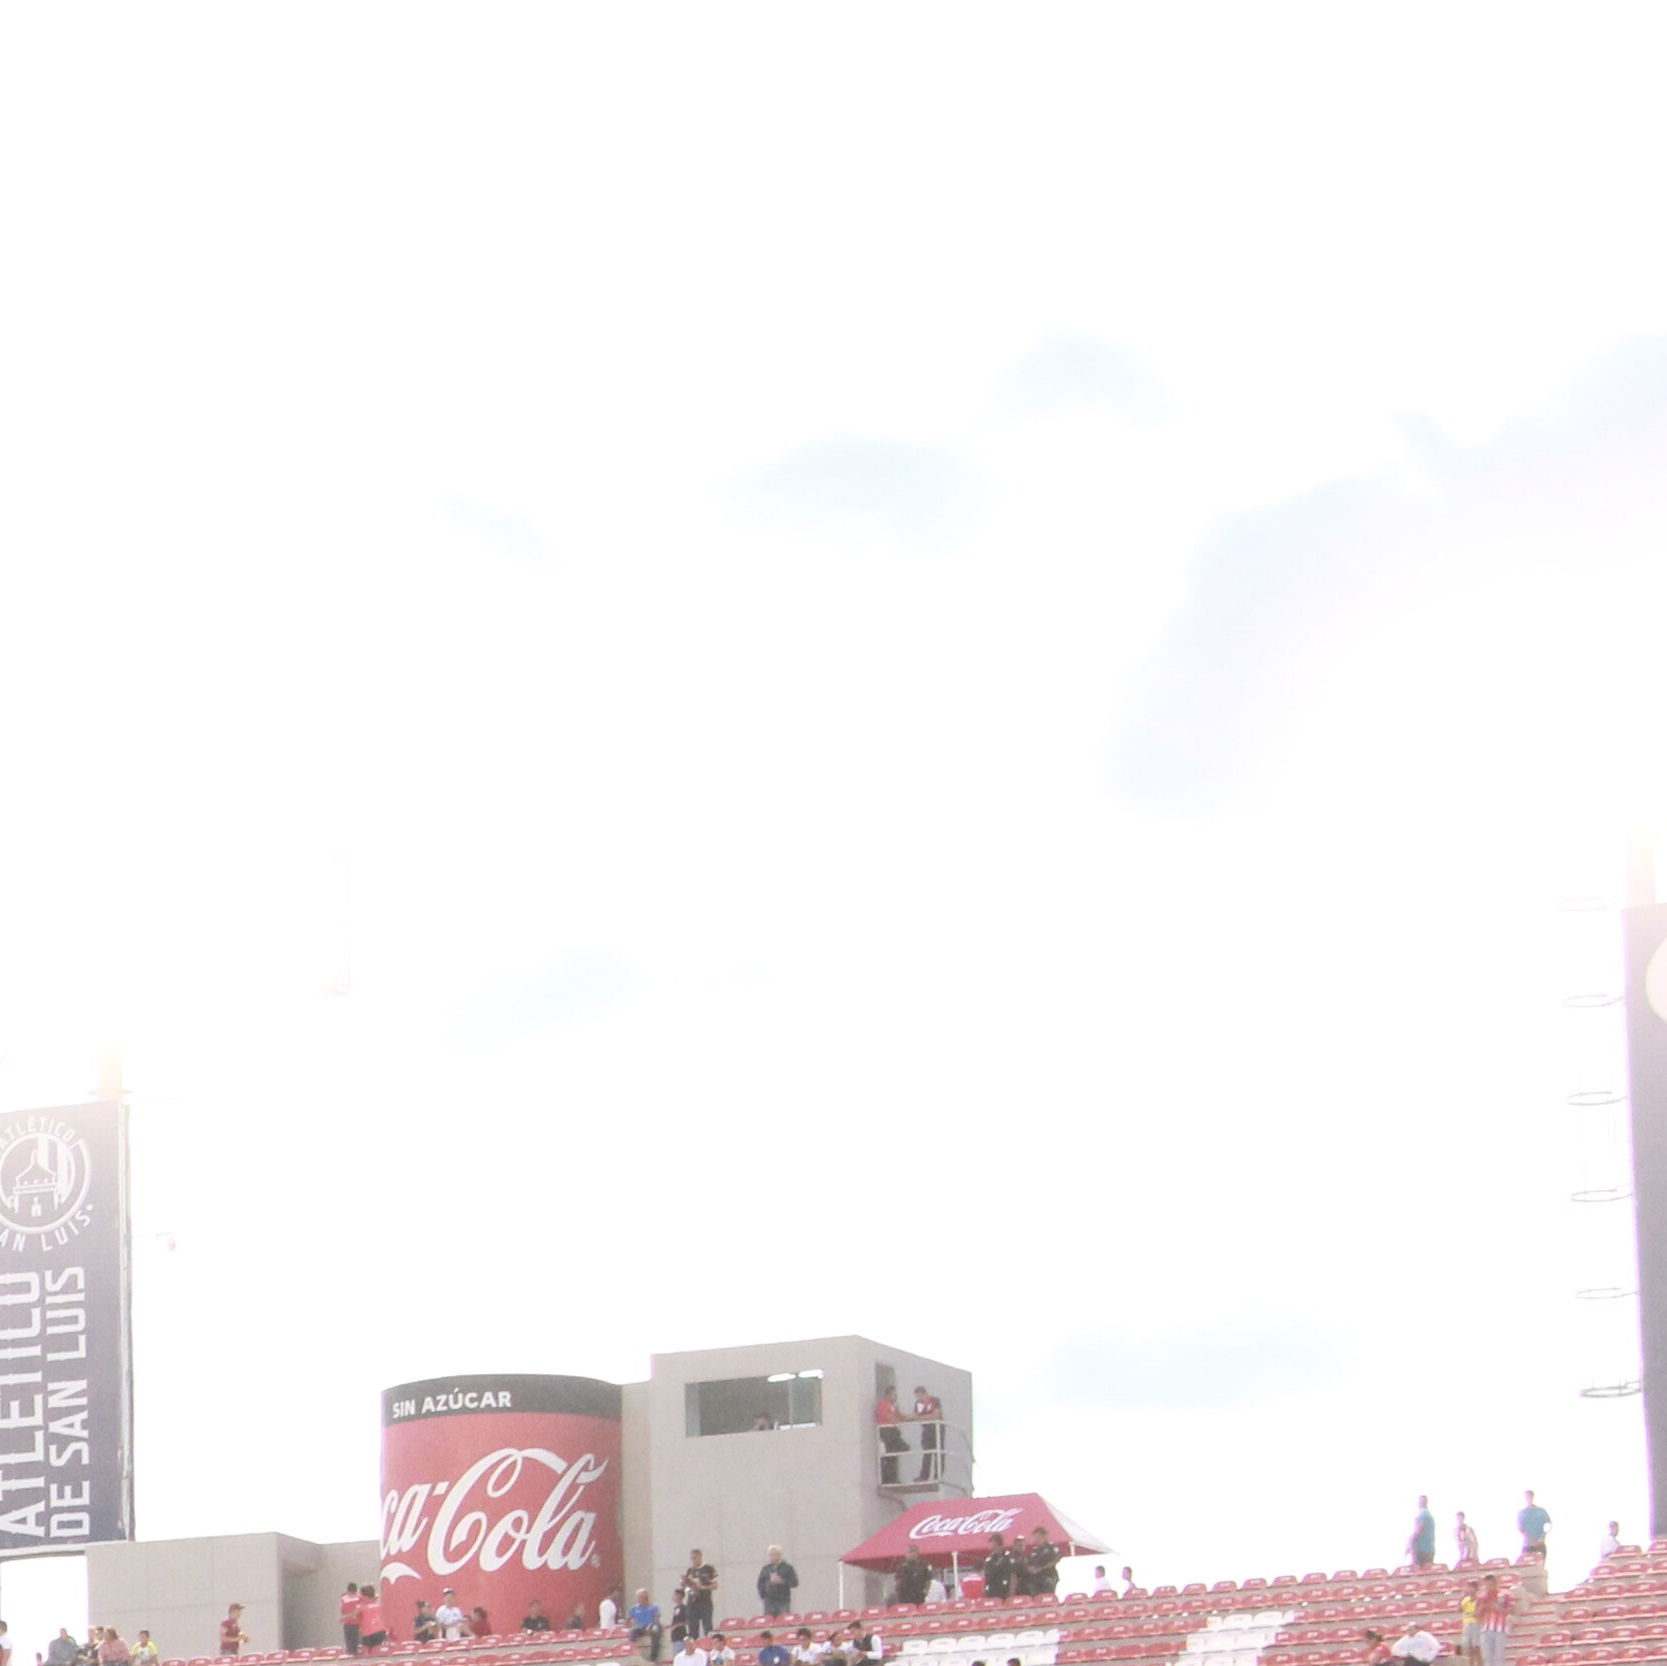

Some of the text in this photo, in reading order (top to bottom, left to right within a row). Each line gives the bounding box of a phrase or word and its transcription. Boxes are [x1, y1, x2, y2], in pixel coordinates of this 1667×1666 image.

[45, 1266, 91, 1538] DE SAN LUIS
[393, 1387, 512, 1418] SIN AZÚCAR
